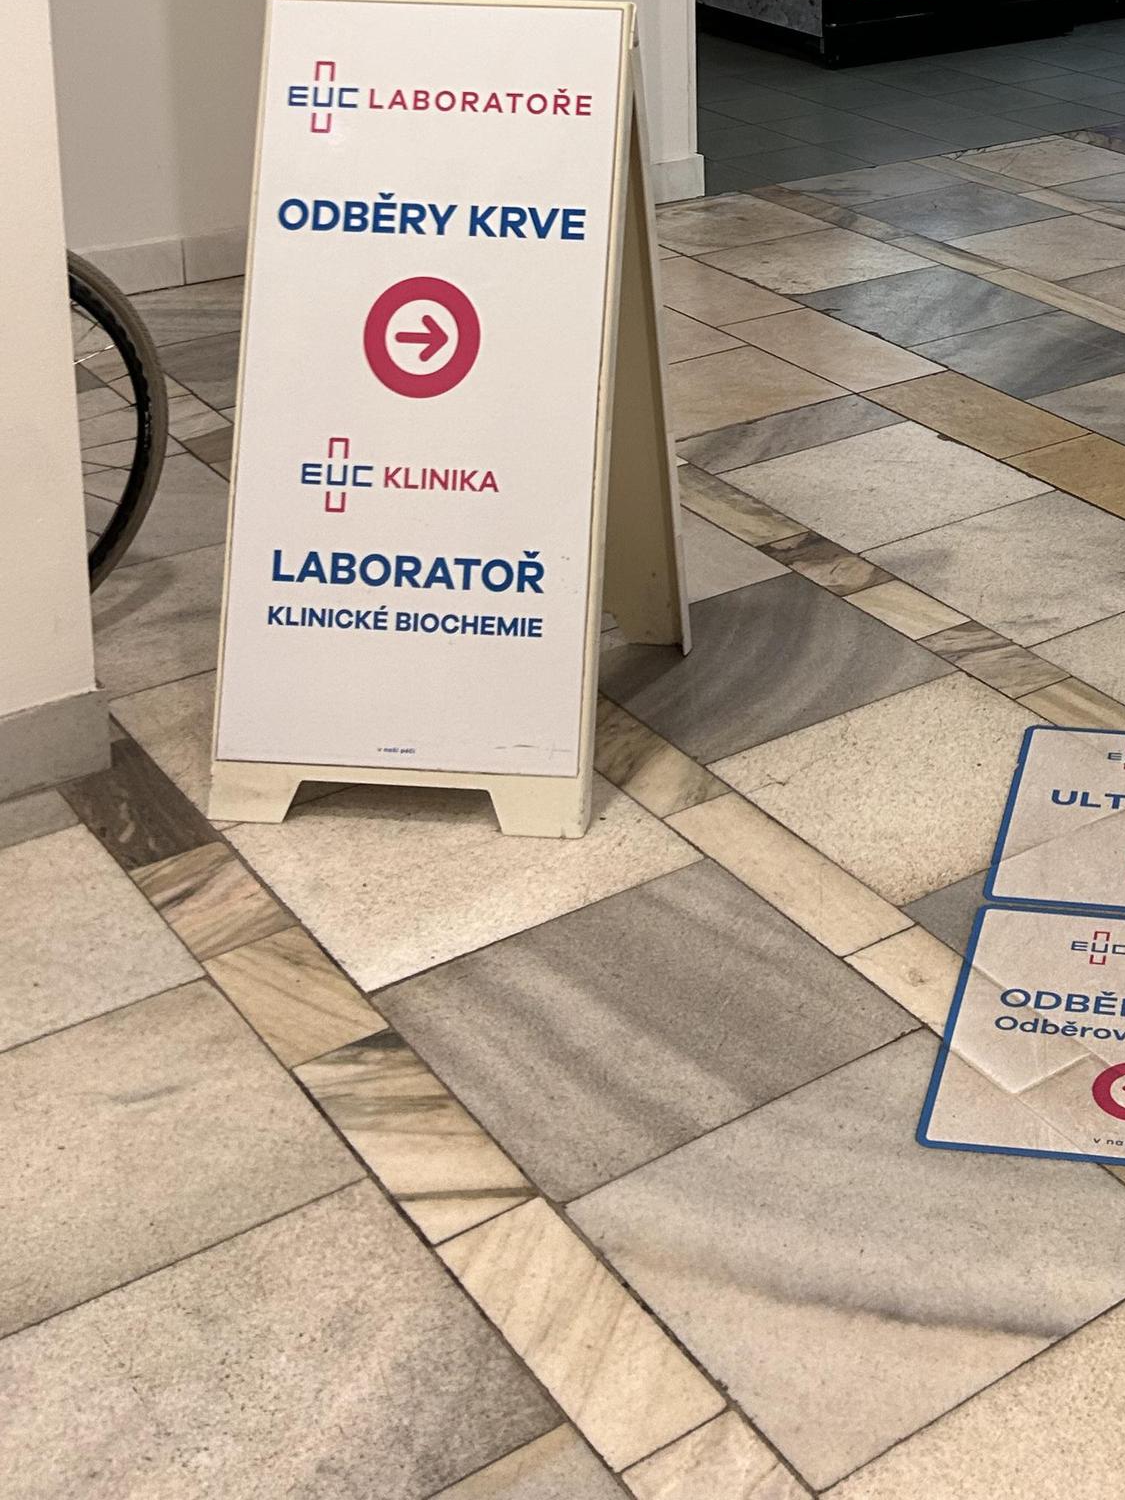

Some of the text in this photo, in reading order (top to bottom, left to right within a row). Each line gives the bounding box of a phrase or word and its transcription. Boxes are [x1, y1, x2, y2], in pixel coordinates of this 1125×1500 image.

[369, 88, 592, 116] LABORATOŘE
[278, 192, 587, 240] ODBĚRY KRVE
[383, 466, 499, 492] KLINIKA
[271, 549, 545, 594] LABORATOŘ
[267, 605, 543, 638] KLINICKÉ BIOCHEMIE
